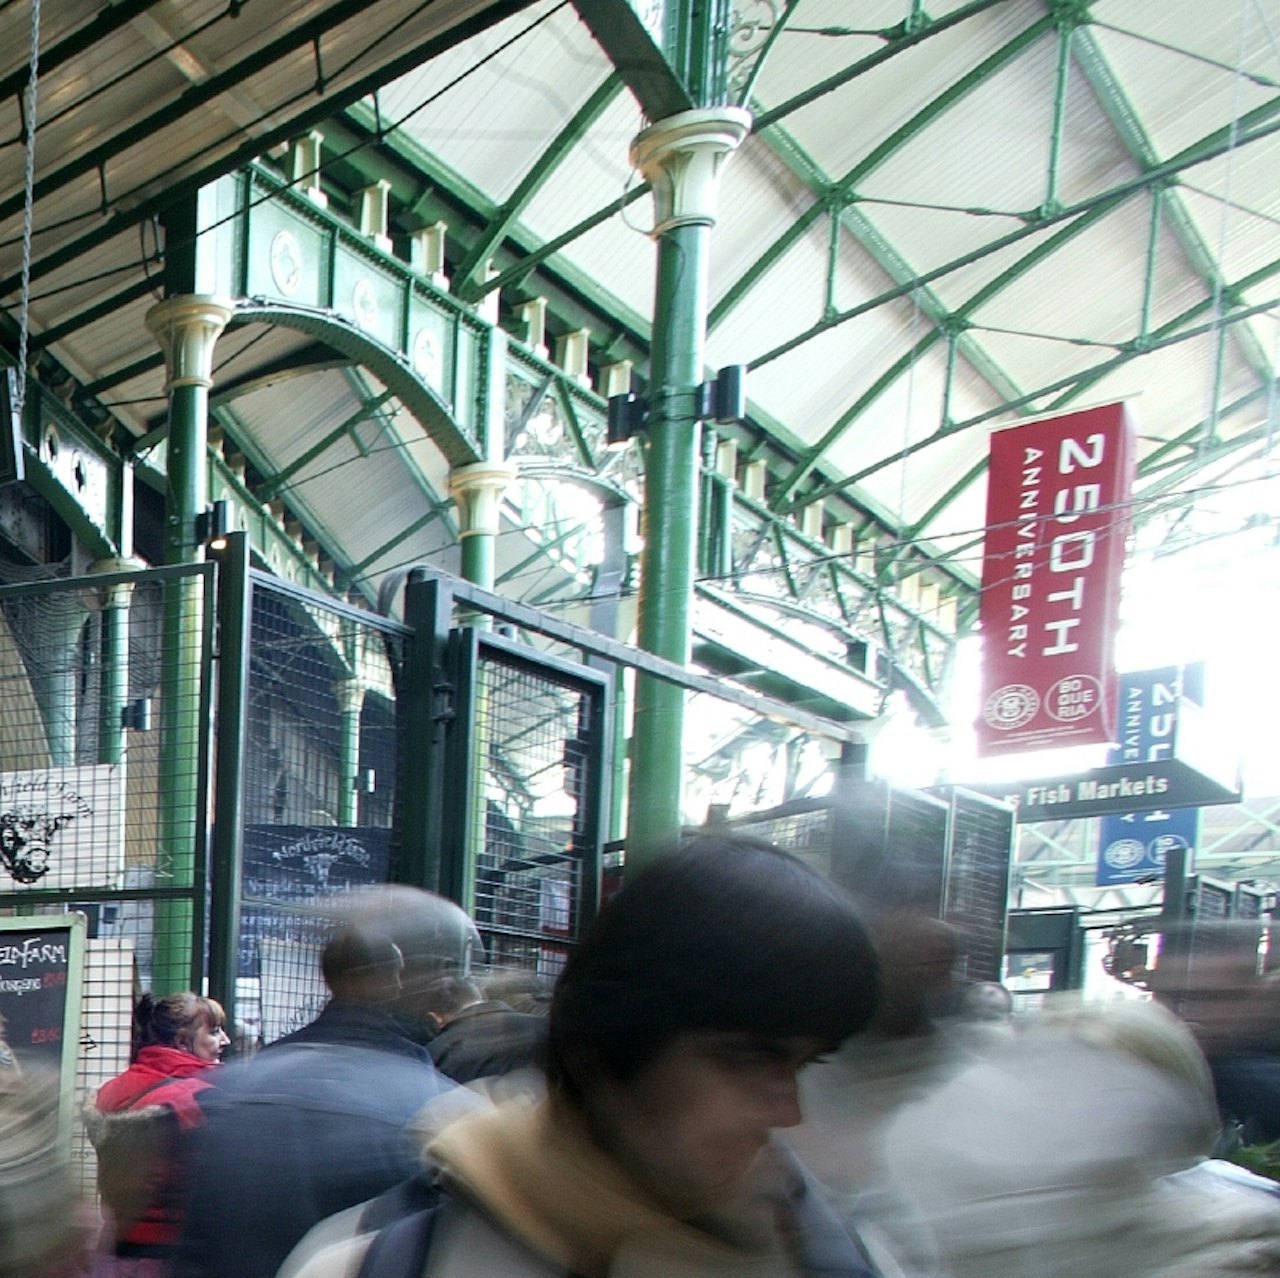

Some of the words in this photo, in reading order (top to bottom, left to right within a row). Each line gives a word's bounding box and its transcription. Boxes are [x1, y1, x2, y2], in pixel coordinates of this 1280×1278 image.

[1007, 447, 1044, 659] ANNIVERSARY
[1042, 433, 1106, 657] 250TH
[1057, 688, 1095, 706] QUE
[1059, 679, 1082, 694] BO
[1057, 703, 1088, 719] RIA
[1027, 783, 1071, 806] Fish
[1076, 774, 1169, 801] Markets
[17, 936, 68, 969] FARM
